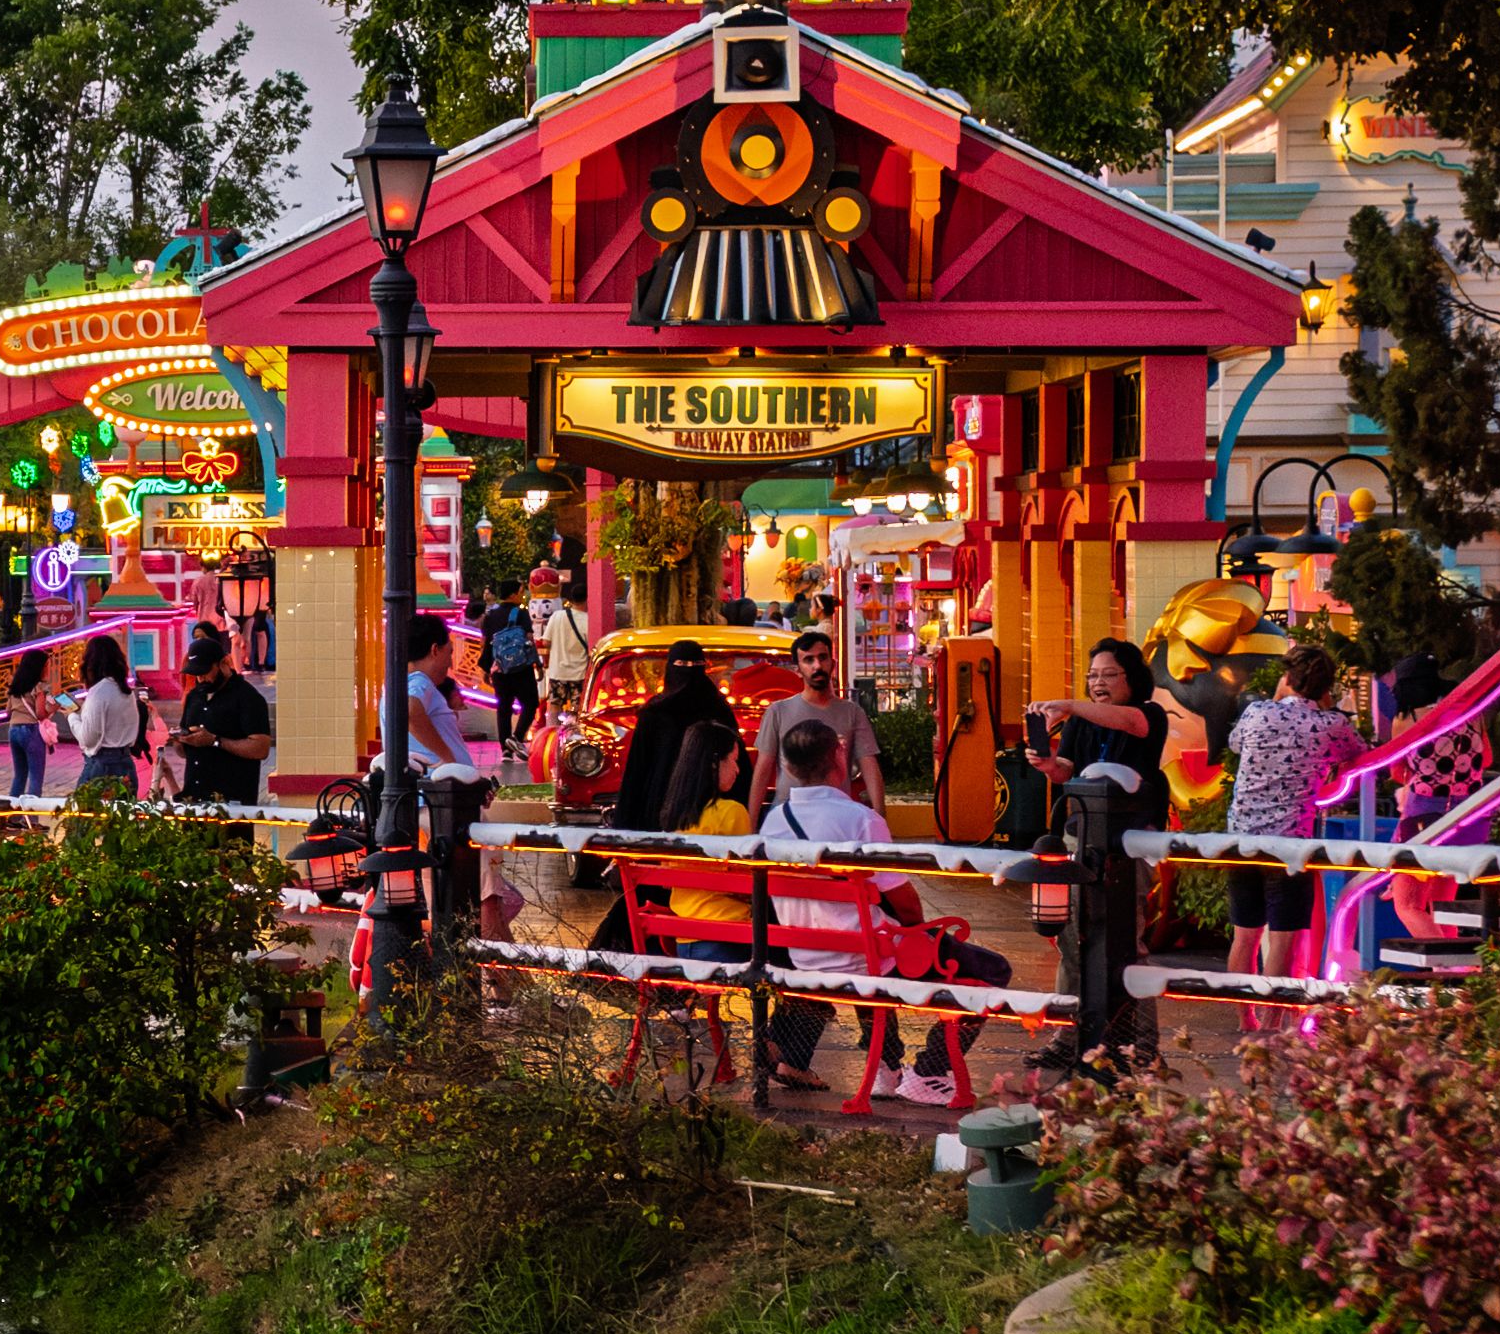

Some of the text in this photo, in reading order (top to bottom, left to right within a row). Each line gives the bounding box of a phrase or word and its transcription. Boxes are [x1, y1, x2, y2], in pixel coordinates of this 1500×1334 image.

[611, 385, 878, 425] THE SOUTHERN
[674, 431, 812, 453] RAILWAY STATION
[167, 501, 267, 518] EXPRESS
[153, 526, 240, 548] PLATFORM
